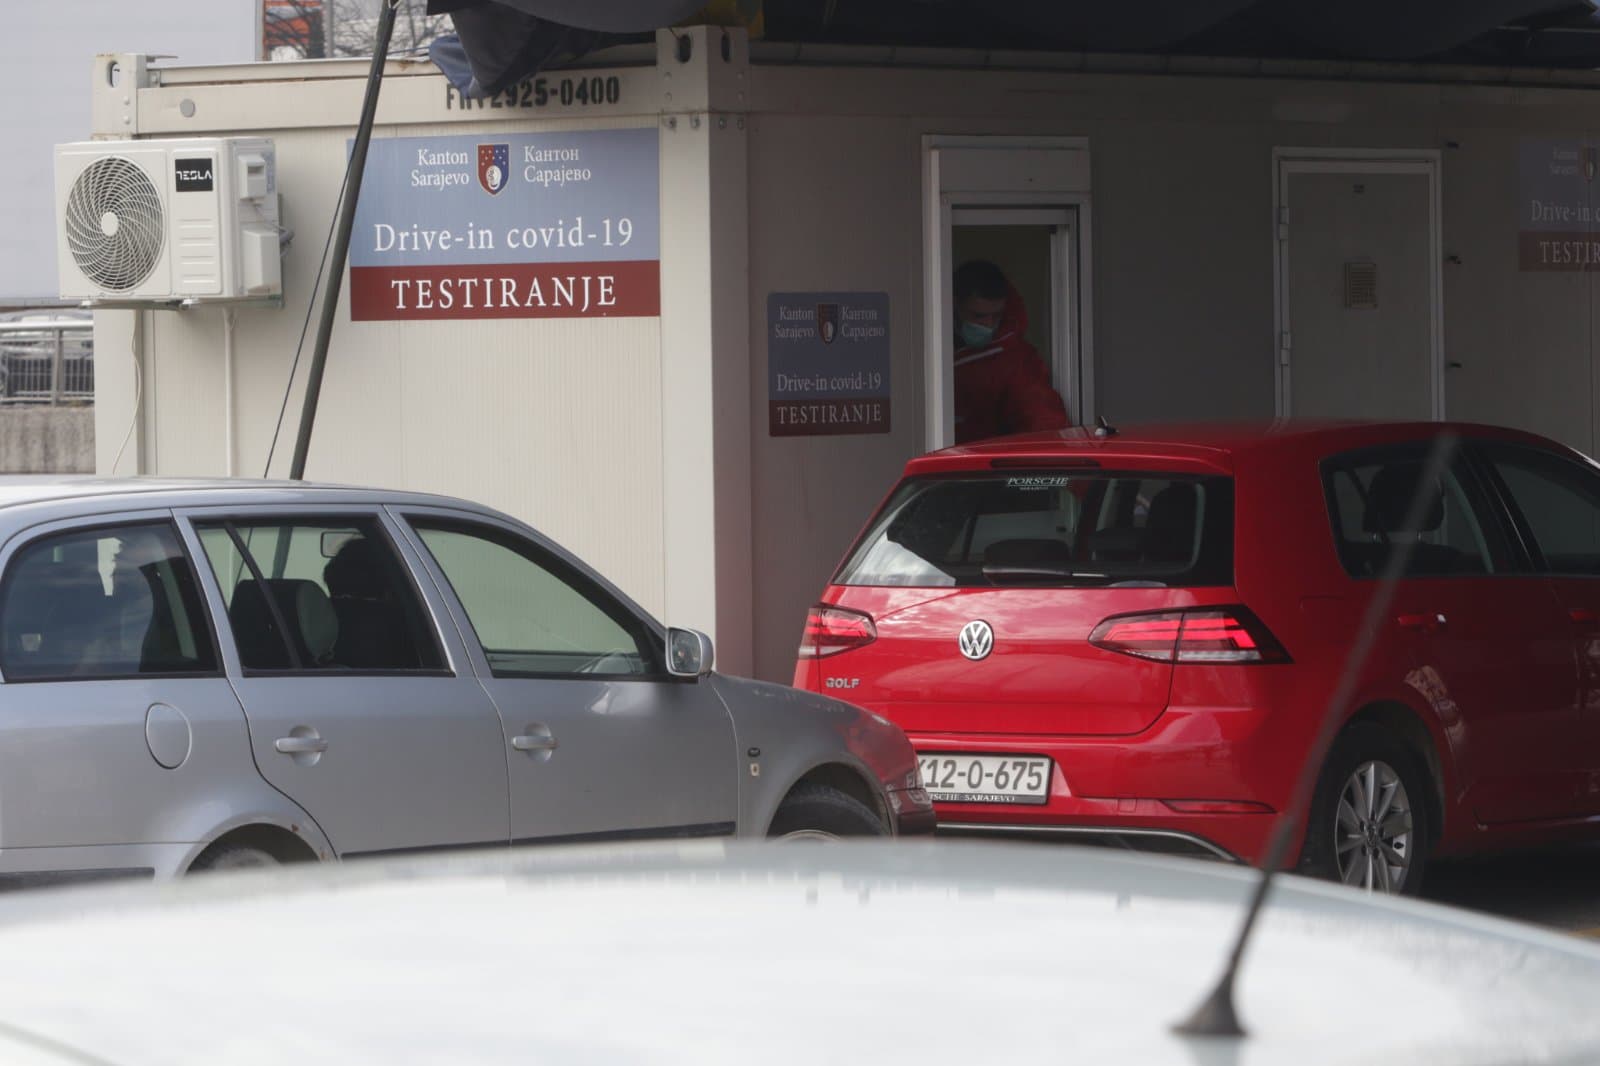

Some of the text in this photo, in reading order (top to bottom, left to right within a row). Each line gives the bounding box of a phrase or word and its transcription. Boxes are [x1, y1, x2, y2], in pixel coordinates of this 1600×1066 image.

[418, 149, 469, 165] Kanton
[524, 146, 580, 162] Кантон
[176, 170, 212, 181] TESLA
[411, 169, 470, 191] Sarajevo
[524, 165, 591, 187] Сарајево
[373, 217, 633, 252] Drive-in covid-19
[391, 275, 616, 312] TESTIRANJE
[779, 306, 814, 321] Kanton
[775, 324, 814, 341] Sarajevo
[776, 371, 881, 392] Drive-in covid-19
[777, 403, 881, 425] TESTIRANJE
[1008, 477, 1069, 485] PORSCHE
[826, 677, 860, 689] GOLF
